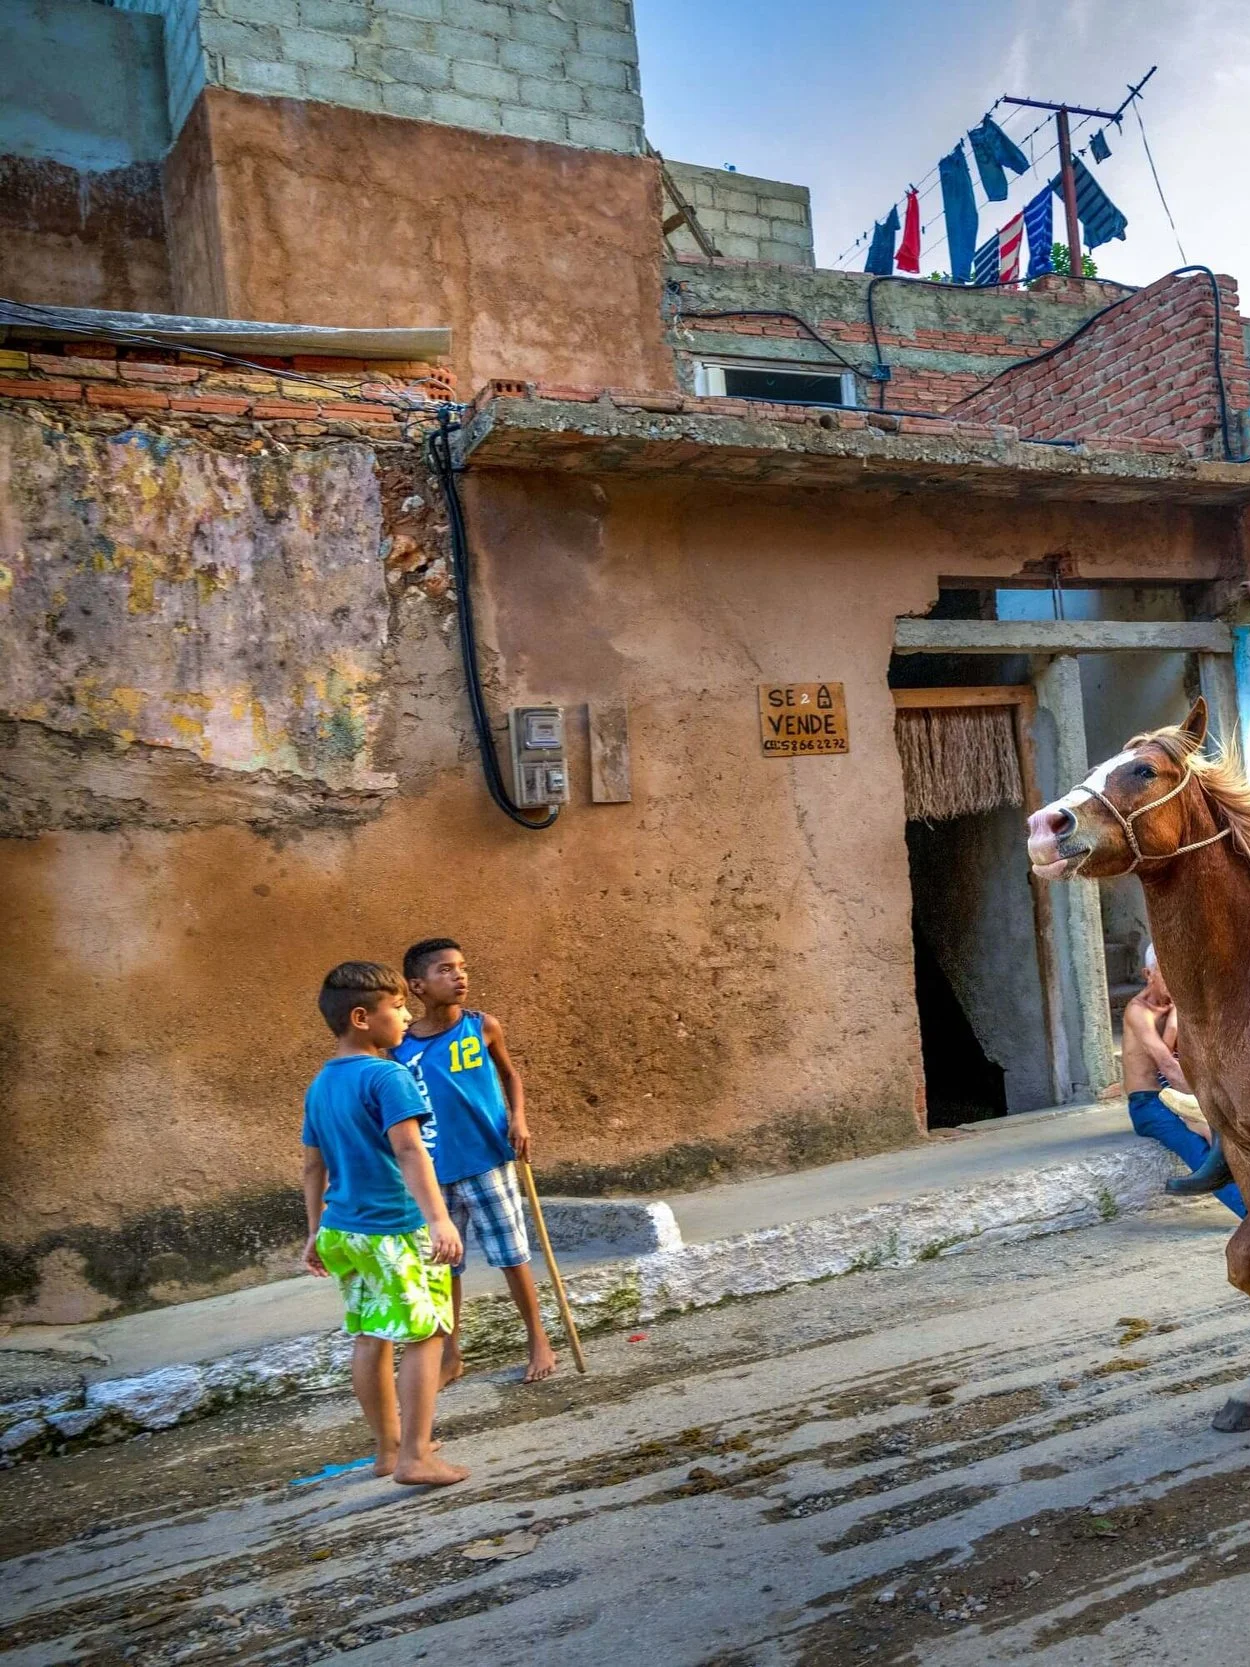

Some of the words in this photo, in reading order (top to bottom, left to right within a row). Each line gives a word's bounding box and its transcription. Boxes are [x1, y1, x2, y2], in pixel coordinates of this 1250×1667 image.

[768, 689, 796, 708] SE
[767, 714, 837, 736] VENDE
[449, 1036, 483, 1073] 12
